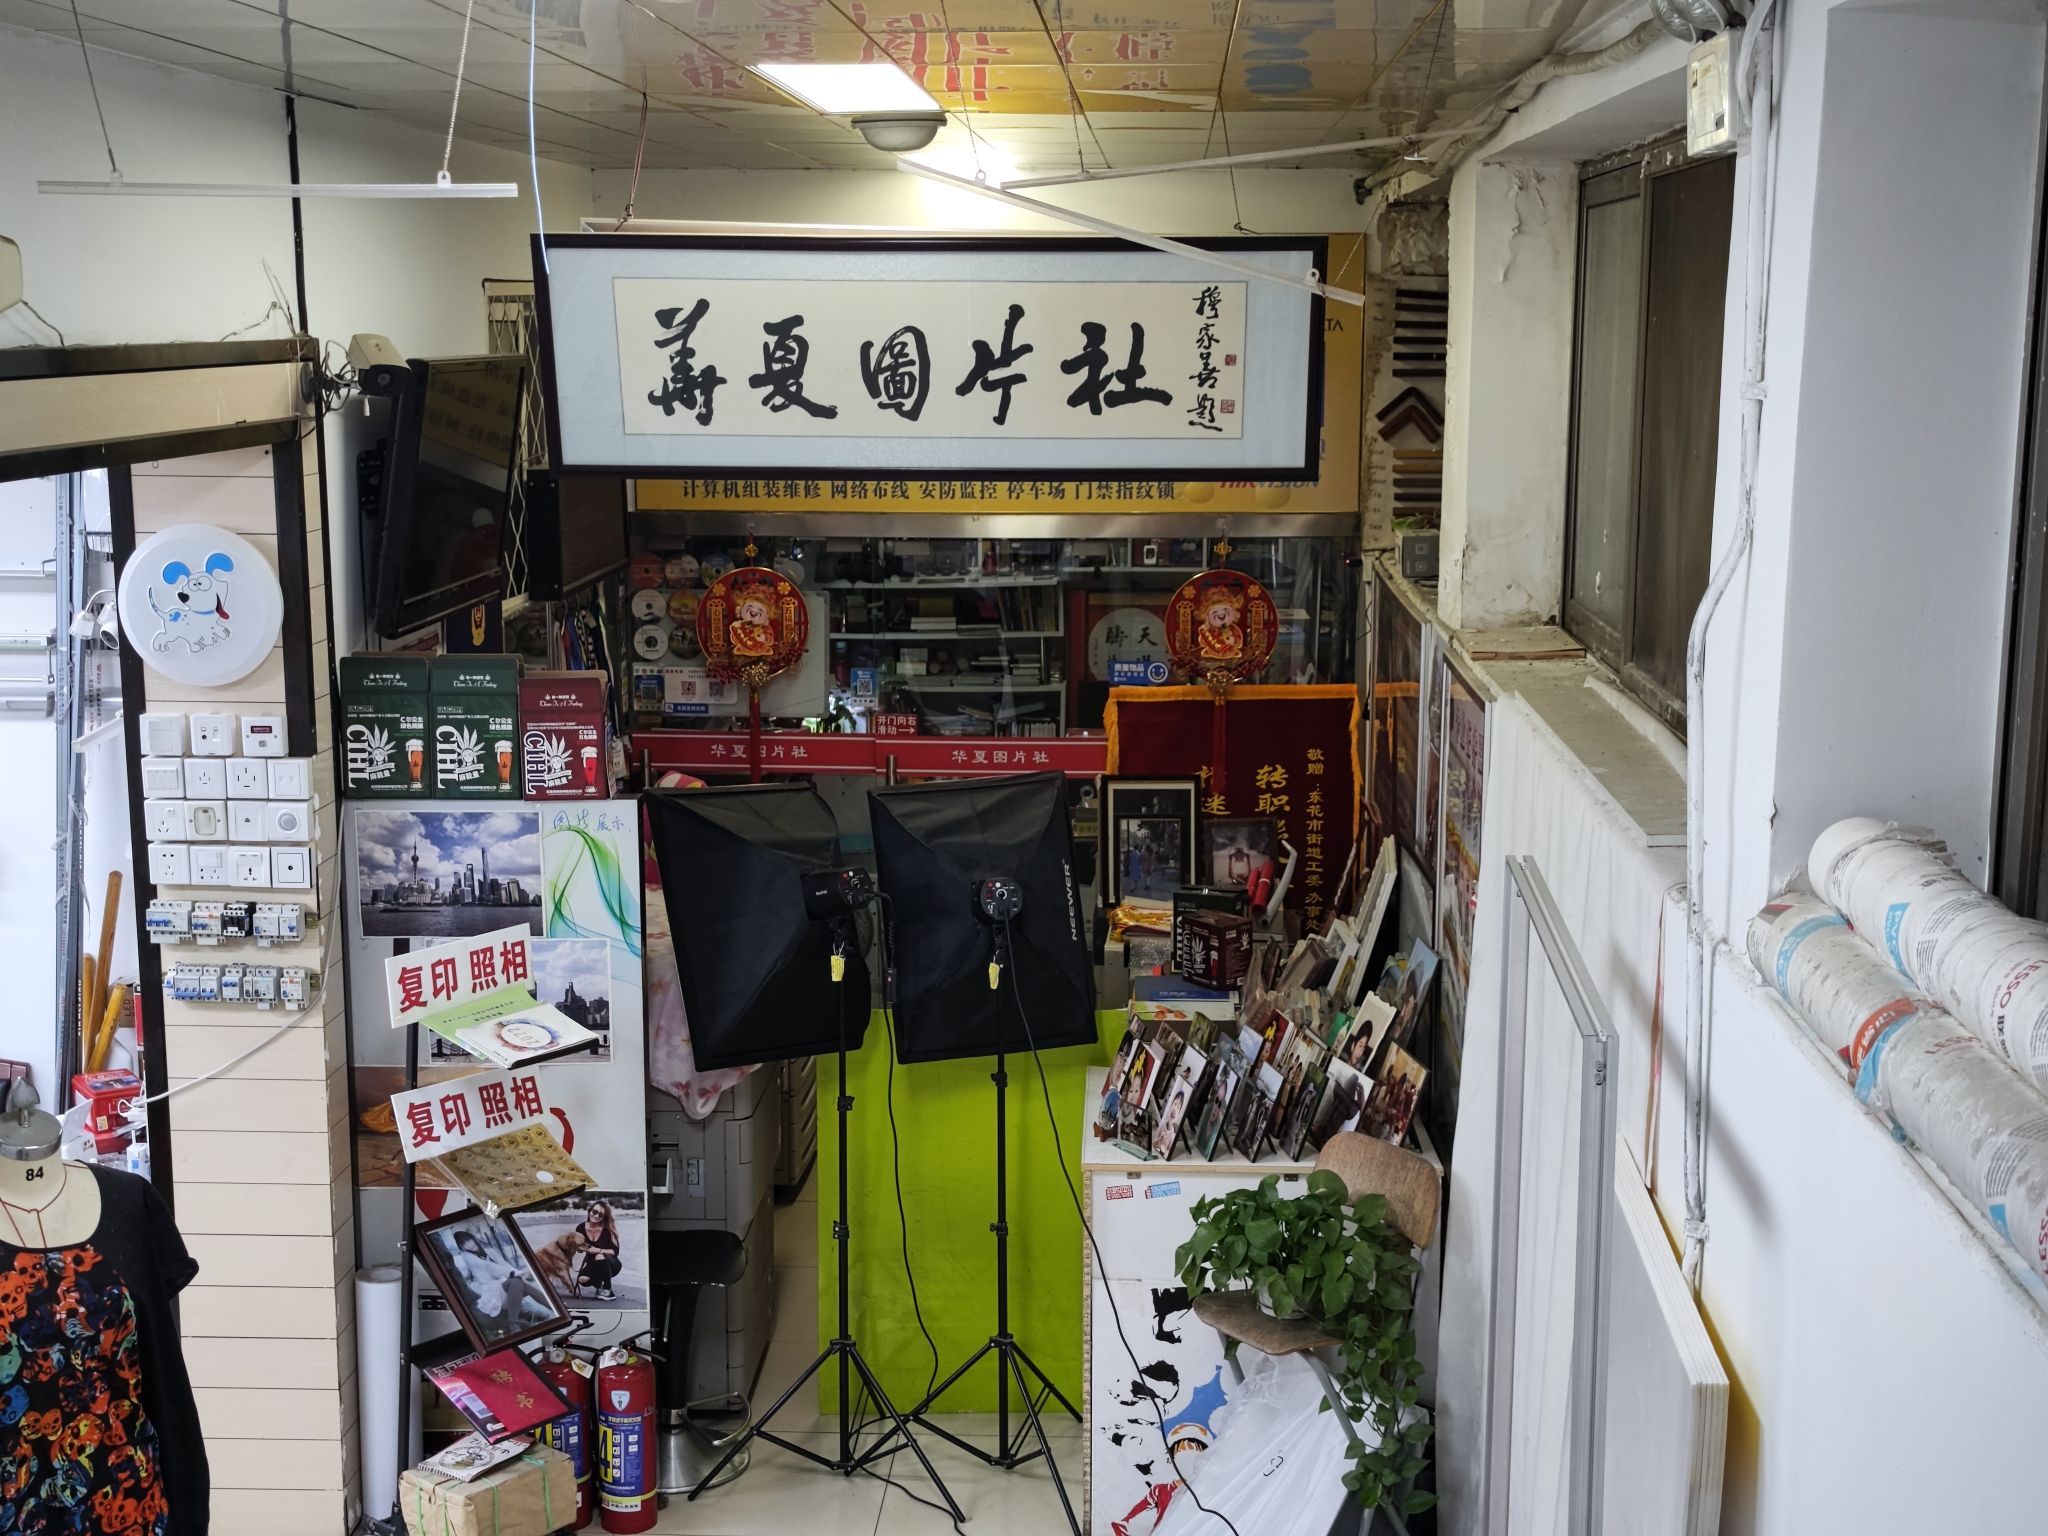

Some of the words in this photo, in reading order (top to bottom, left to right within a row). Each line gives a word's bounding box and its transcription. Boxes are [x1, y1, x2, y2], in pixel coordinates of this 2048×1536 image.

[1007, 481, 1066, 500] 停车场
[876, 715, 916, 726] 开门向右
[876, 726, 897, 735] 滑动
[952, 749, 1050, 763] 华夏图片社
[1063, 863, 1078, 941] NEEWER
[397, 958, 458, 1013] 复印
[469, 940, 528, 993] 照相
[407, 1093, 470, 1148] 复印
[478, 1075, 544, 1128] 照相
[25, 1166, 44, 1182] 84
